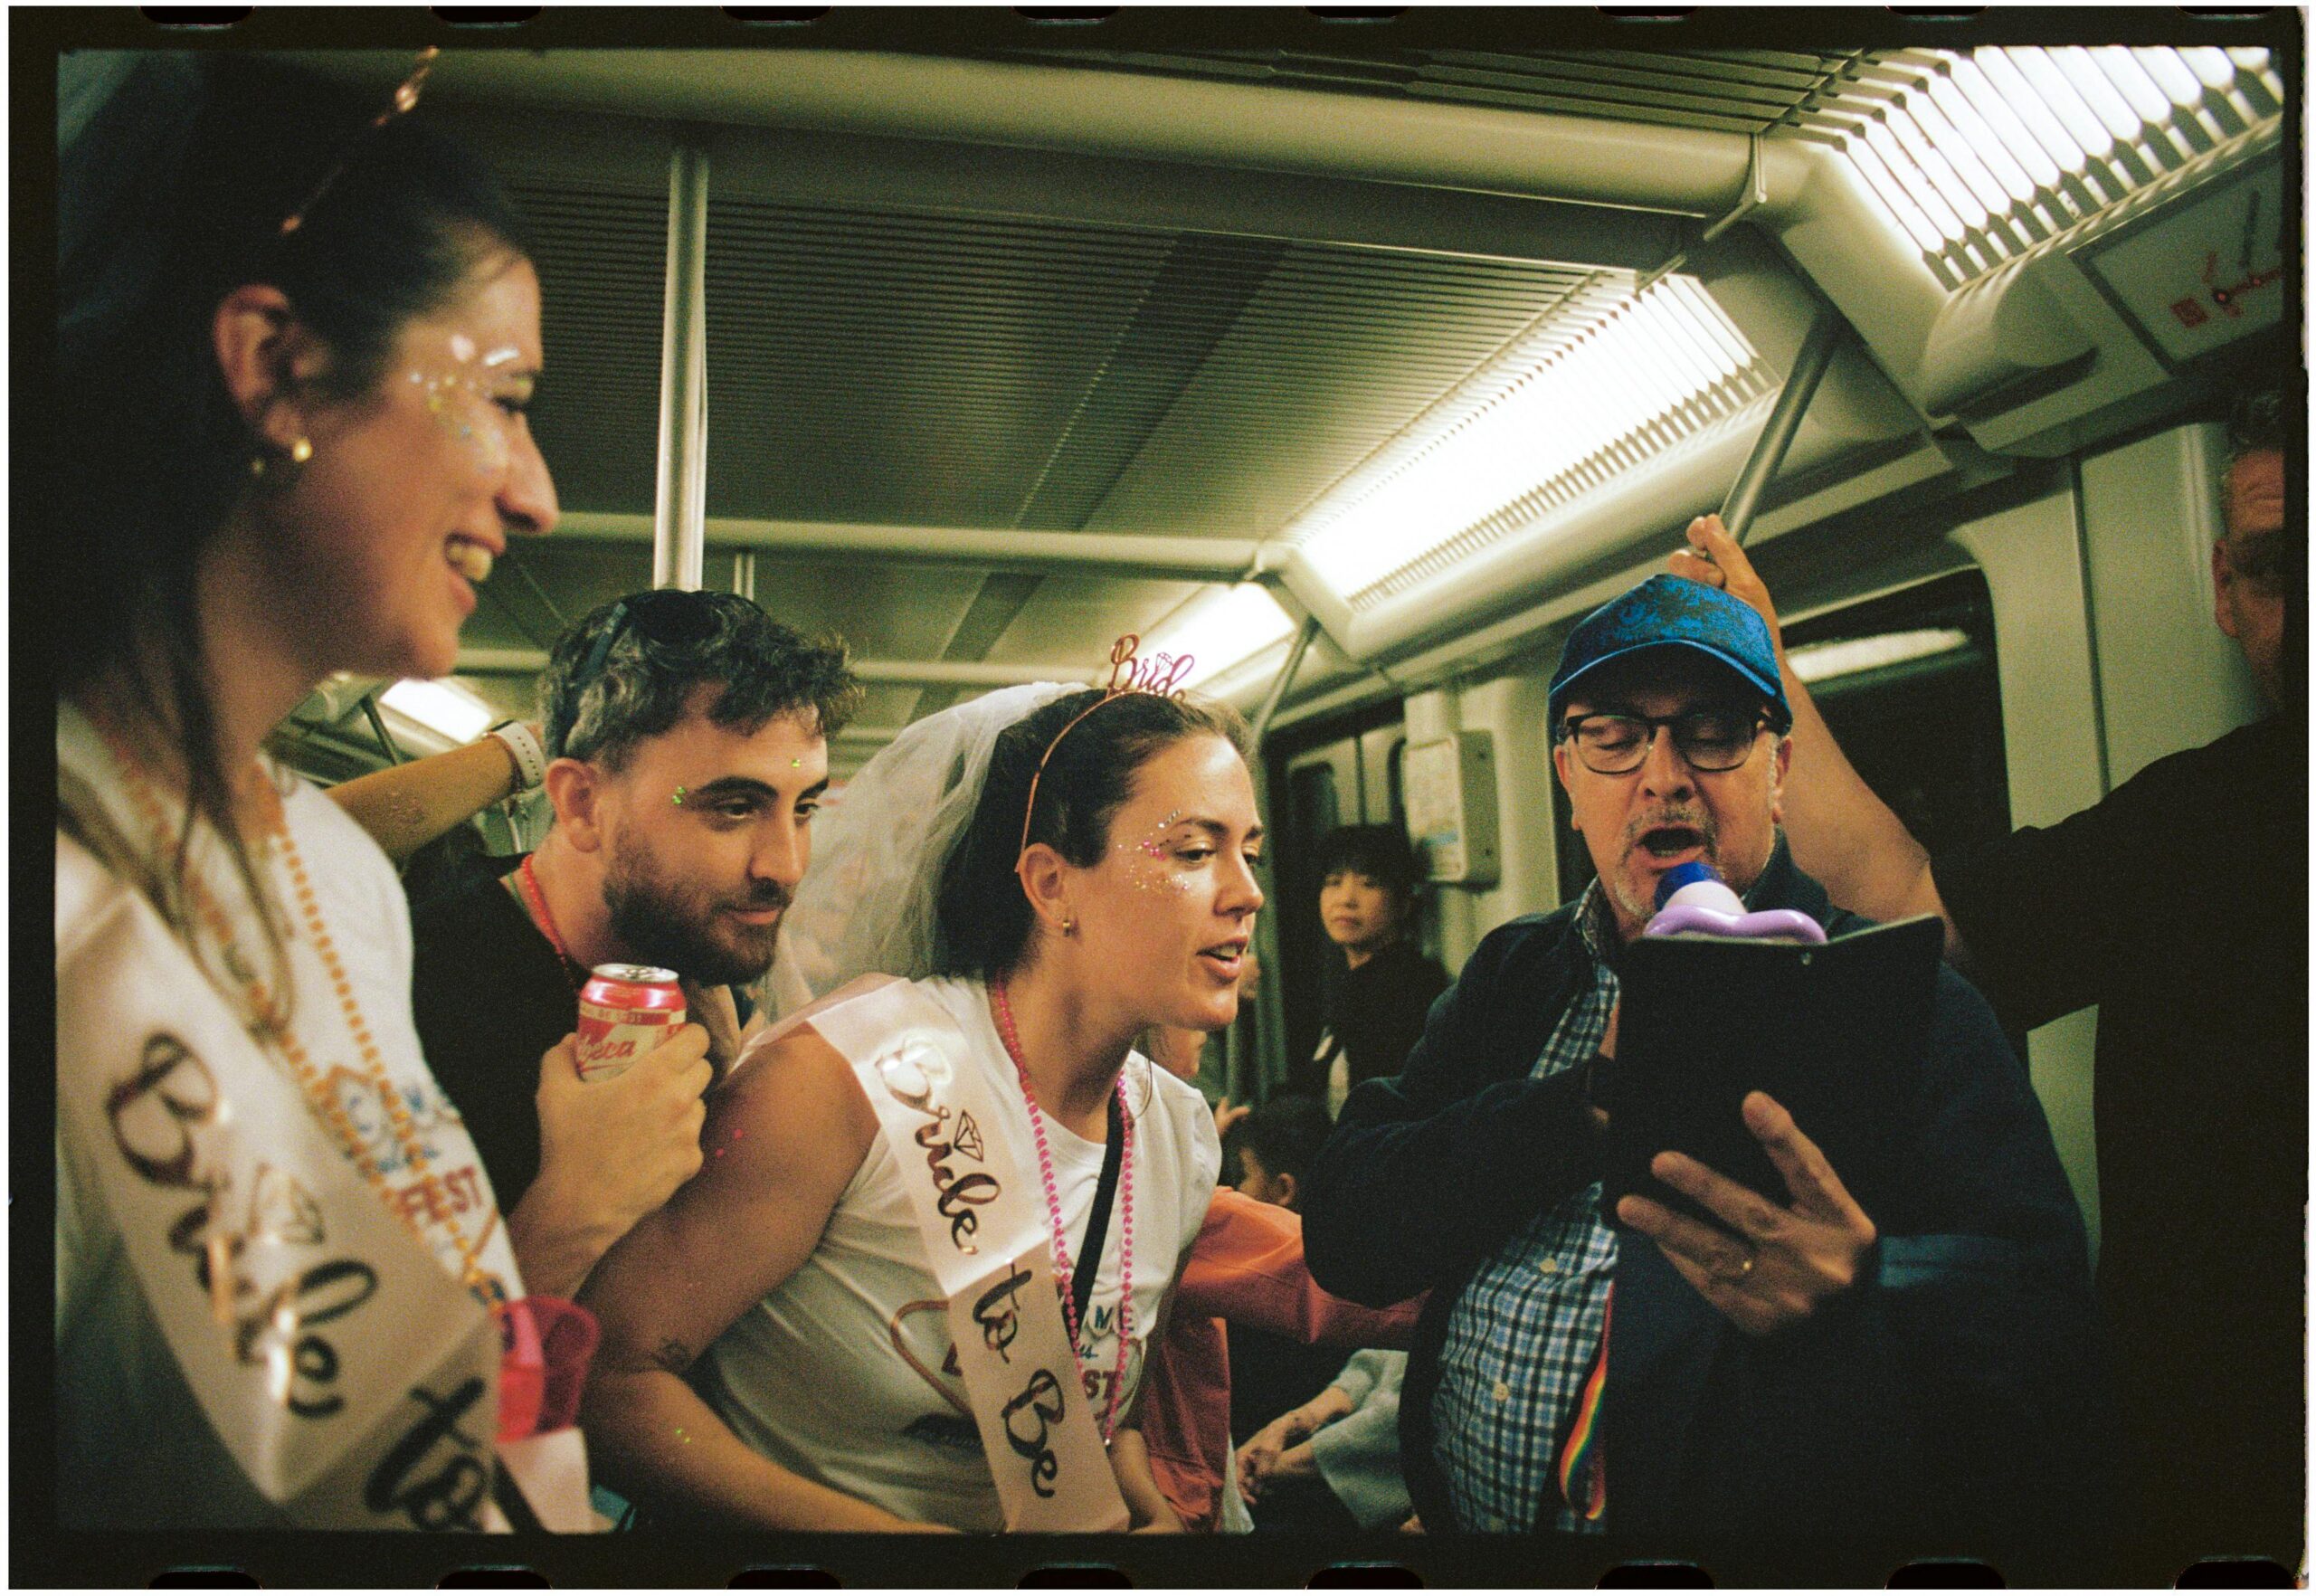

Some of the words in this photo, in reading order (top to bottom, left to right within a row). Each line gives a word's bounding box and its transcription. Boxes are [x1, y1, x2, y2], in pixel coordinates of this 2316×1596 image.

[874, 1030, 1001, 1256] Bride
[104, 1031, 378, 1419] Bride
[365, 1375, 487, 1530] to
[972, 1259, 1033, 1364] to
[1001, 1367, 1066, 1499] Be
